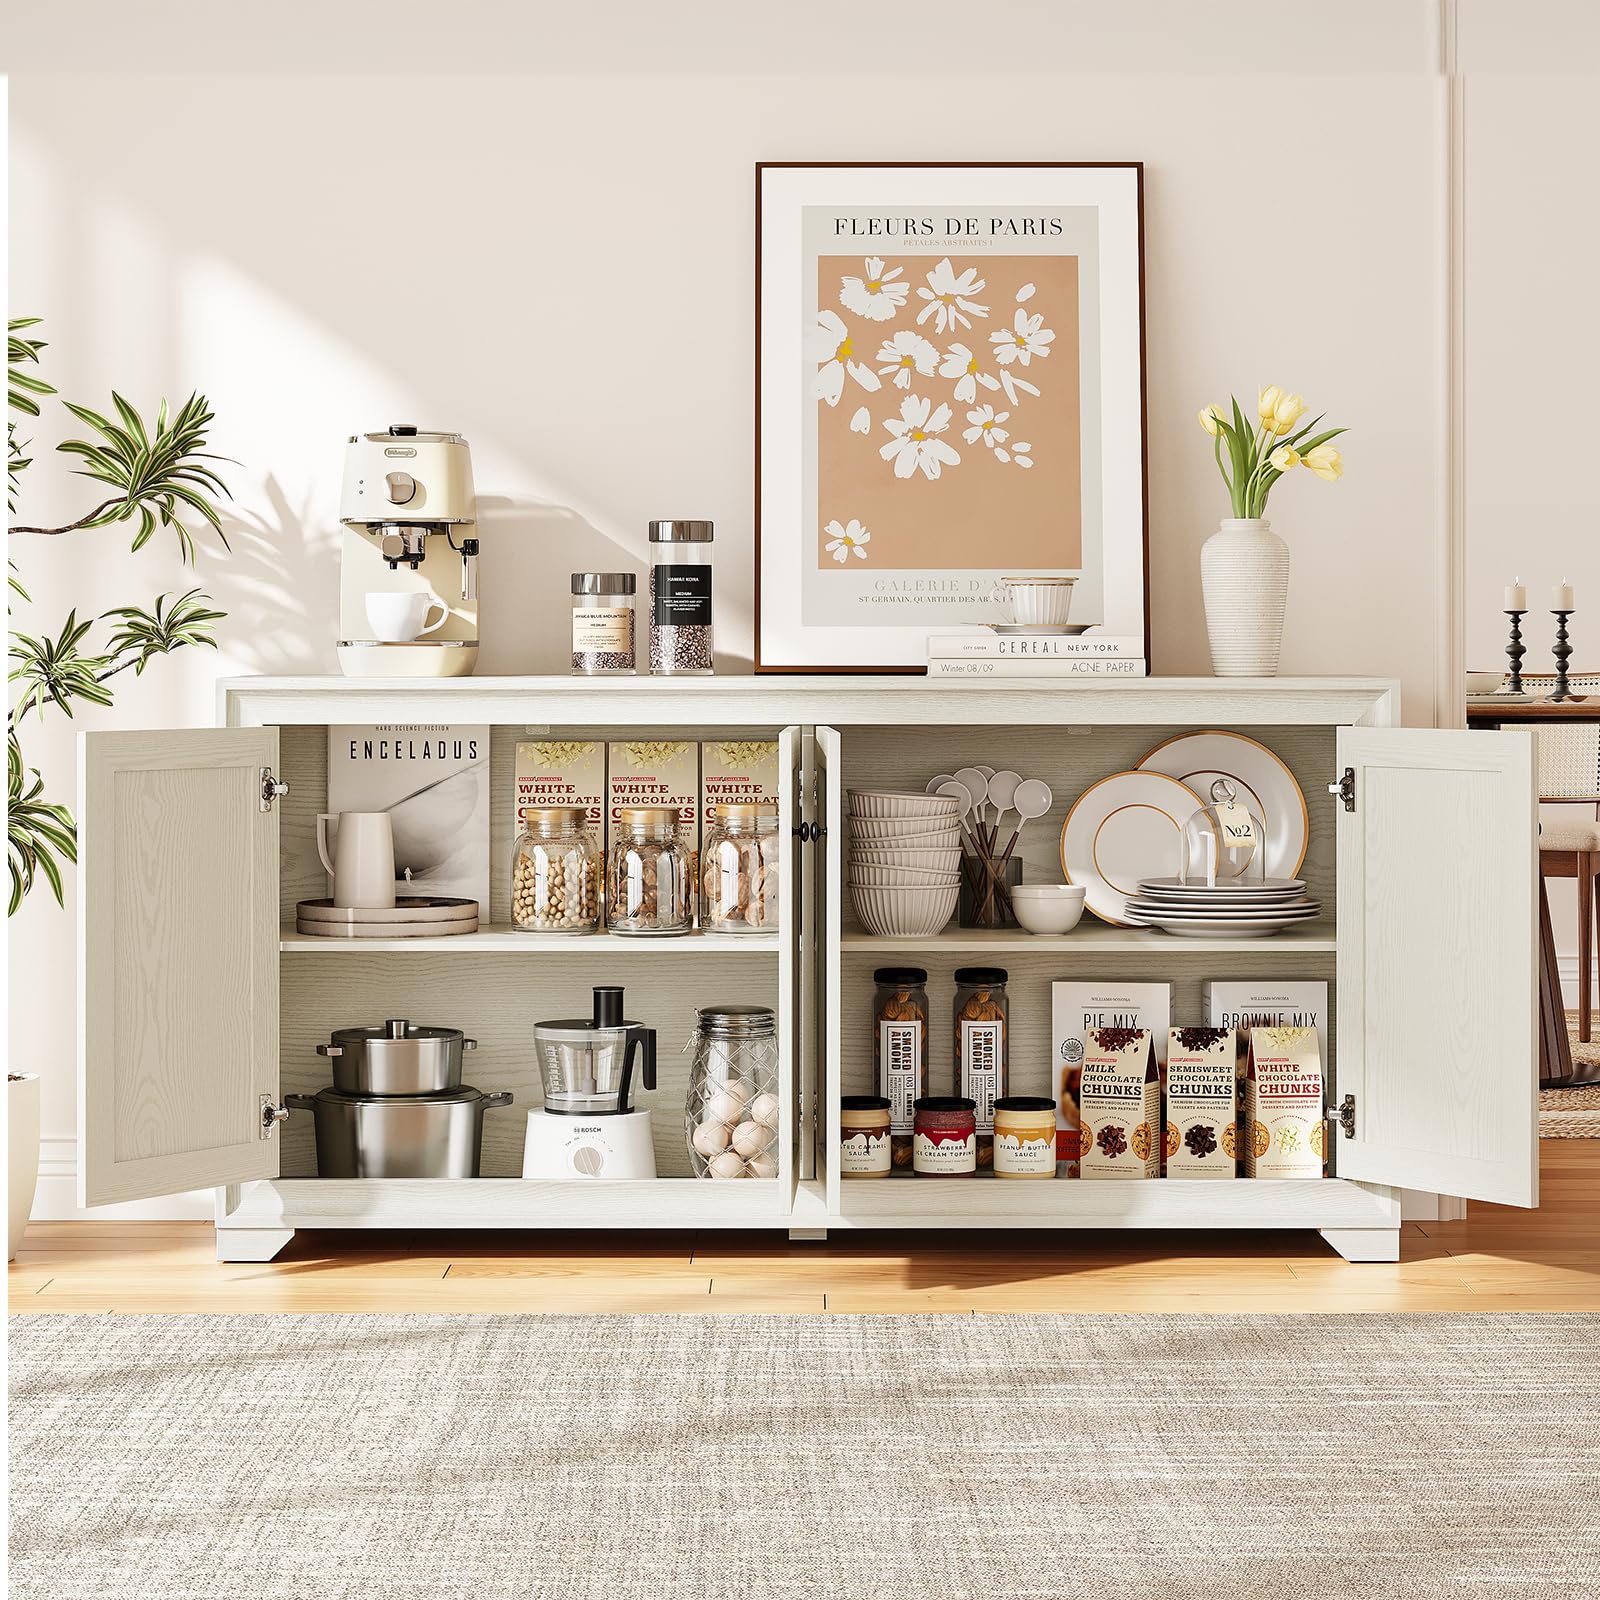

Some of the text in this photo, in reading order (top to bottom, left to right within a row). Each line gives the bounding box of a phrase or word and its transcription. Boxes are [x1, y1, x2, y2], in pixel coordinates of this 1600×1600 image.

[833, 217, 1063, 236] FLEURS DE PARIS
[875, 580, 959, 592] GALERIE
[871, 596, 912, 604] GERMAIN,
[914, 596, 957, 604] QUARTIER
[999, 641, 1059, 653] CEREAL
[940, 663, 994, 673] Winter 08/09
[1071, 662, 1135, 673] ACNE PAPER
[350, 740, 477, 760] ENCELADUS
[518, 784, 575, 794] WHITE
[612, 784, 669, 794] WHITE
[705, 784, 763, 794] WHITE
[518, 796, 601, 804] CHOCOLATE
[612, 796, 695, 804] CHOCOLATE
[705, 796, 780, 804] CHOCOLAT
[1084, 1013, 1138, 1030] PIE MIX
[1222, 1012, 1285, 1030] BROWNIE
[1293, 1012, 1317, 1028] MIX
[891, 1031, 901, 1070] ALMOND
[902, 1031, 912, 1070] SMOKED
[972, 1031, 982, 1070] ALMOND
[983, 1031, 993, 1070] SMOKED
[1084, 1064, 1116, 1073] MILK
[1169, 1065, 1232, 1073] SEMISWEET
[1257, 1064, 1300, 1072] WHITE
[906, 1076, 914, 1088] 03
[987, 1076, 995, 1088] 03
[1083, 1074, 1143, 1083] CHOCOLATE
[1082, 1083, 1142, 1096] CHUNKS
[1169, 1084, 1232, 1095] CHUNKS
[1258, 1083, 1320, 1094] CHUNKS
